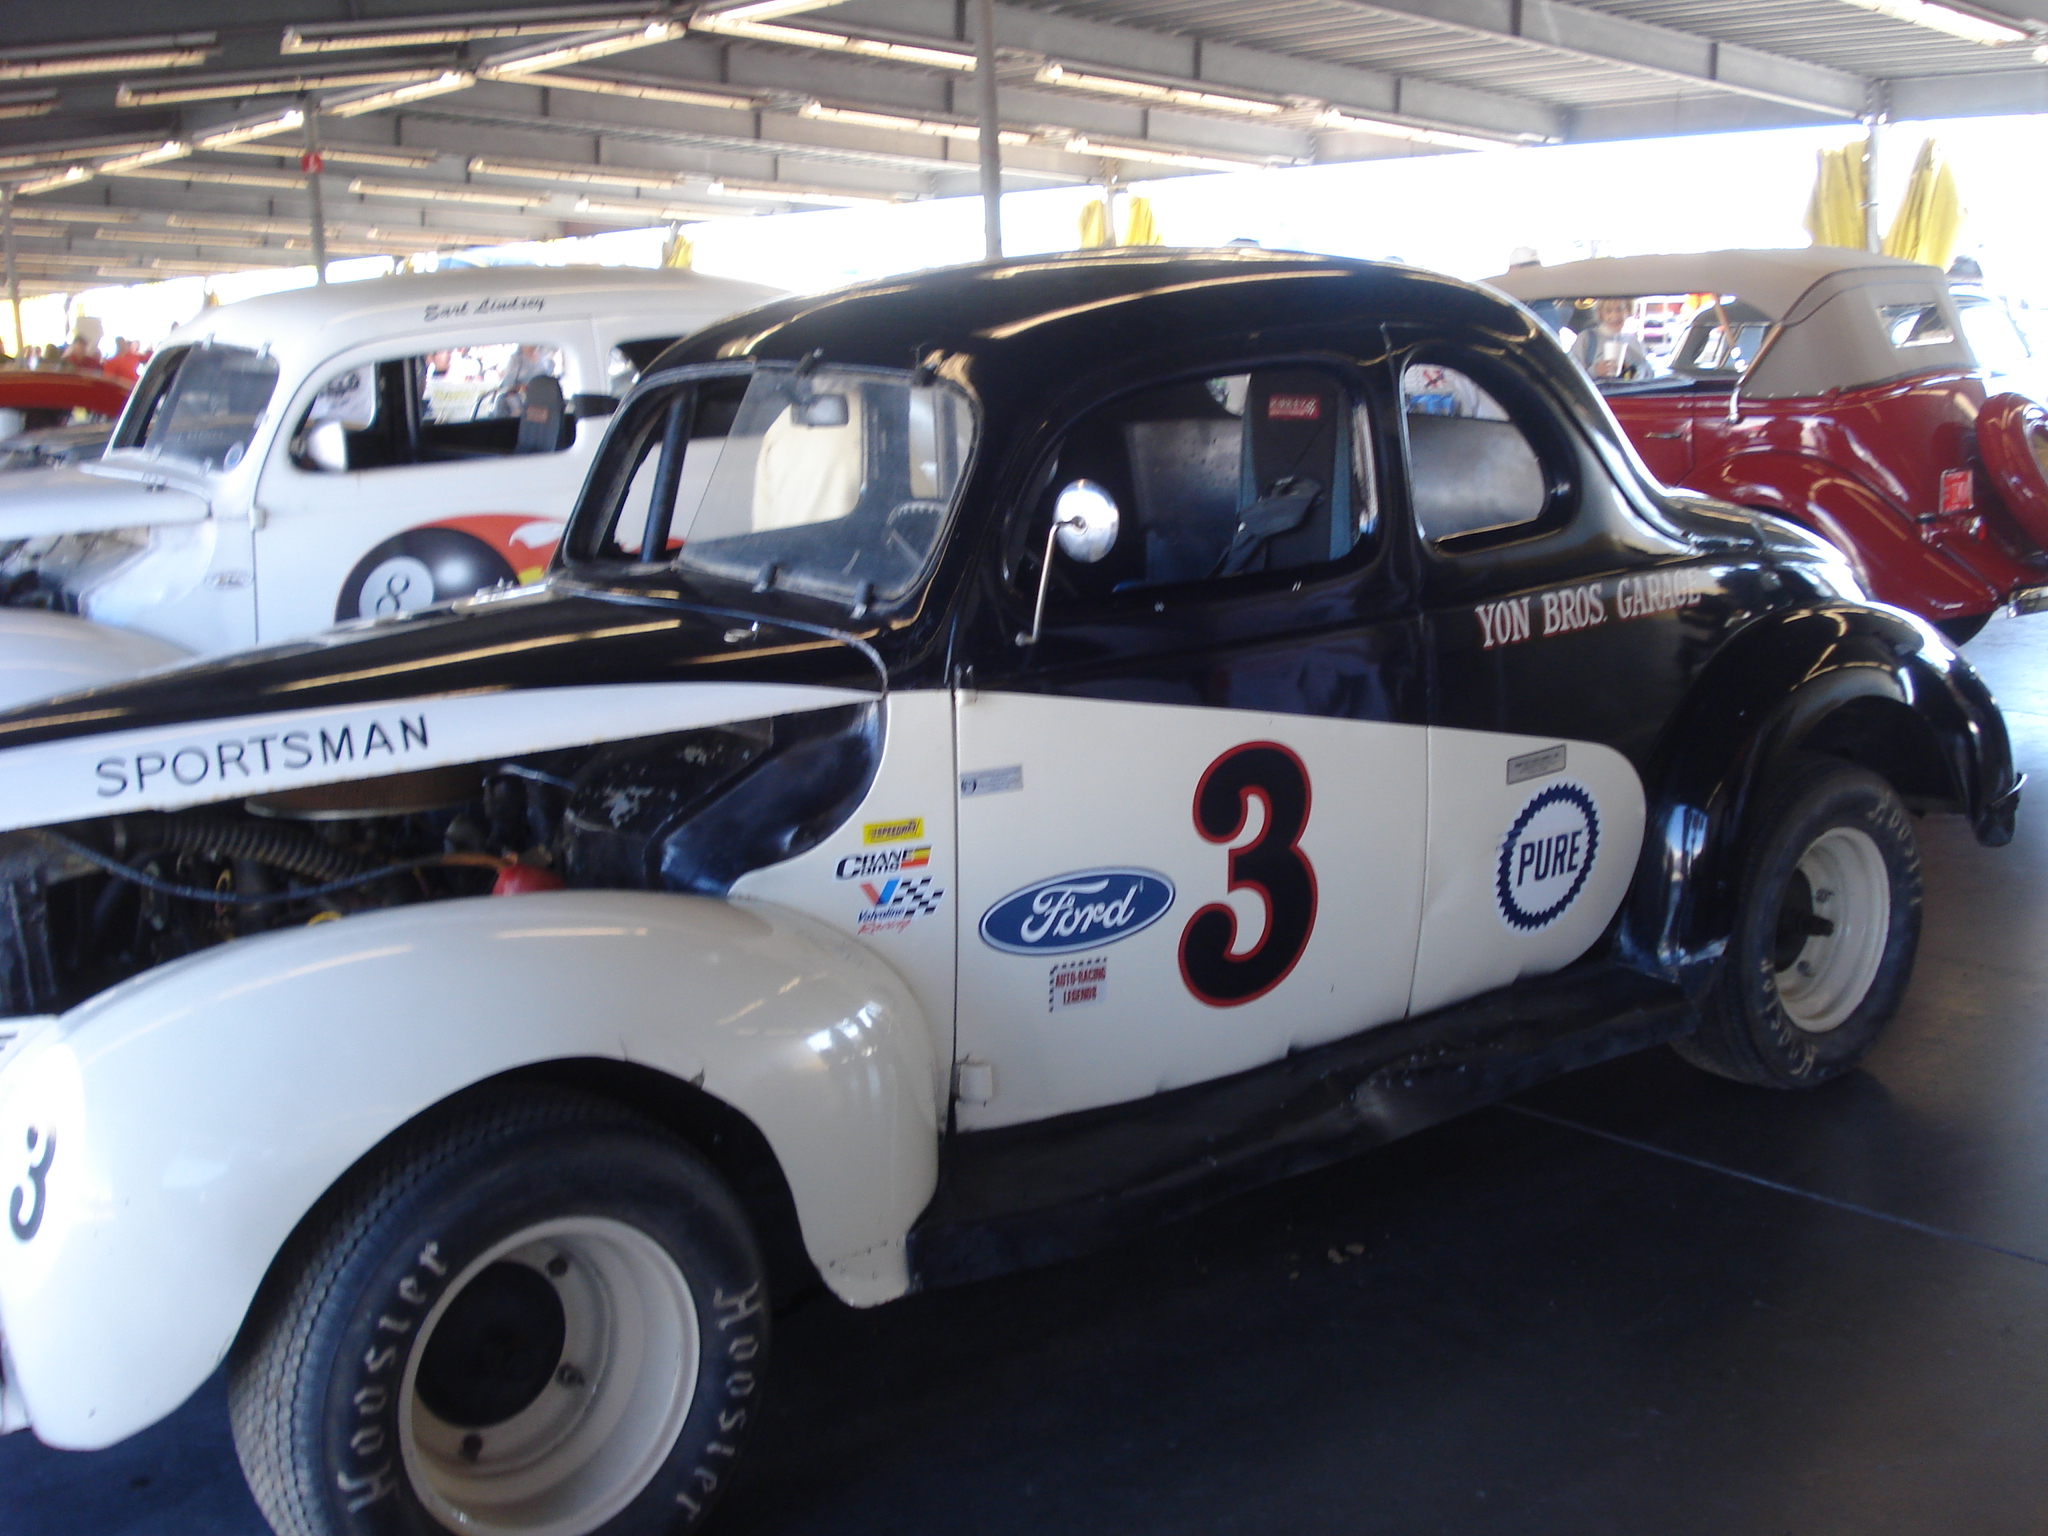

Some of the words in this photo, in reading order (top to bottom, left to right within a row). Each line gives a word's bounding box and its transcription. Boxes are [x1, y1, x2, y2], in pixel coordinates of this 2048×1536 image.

[424, 301, 469, 322] Earl
[1475, 596, 1532, 649] YON
[1616, 566, 1702, 622] GARAGE
[95, 713, 430, 798] SPORTSMAN
[1178, 741, 1318, 1008] 3
[1516, 828, 1583, 887] PURE
[858, 908, 904, 922] Valvoline
[1020, 878, 1144, 943] Ford
[8, 1122, 57, 1243] 3
